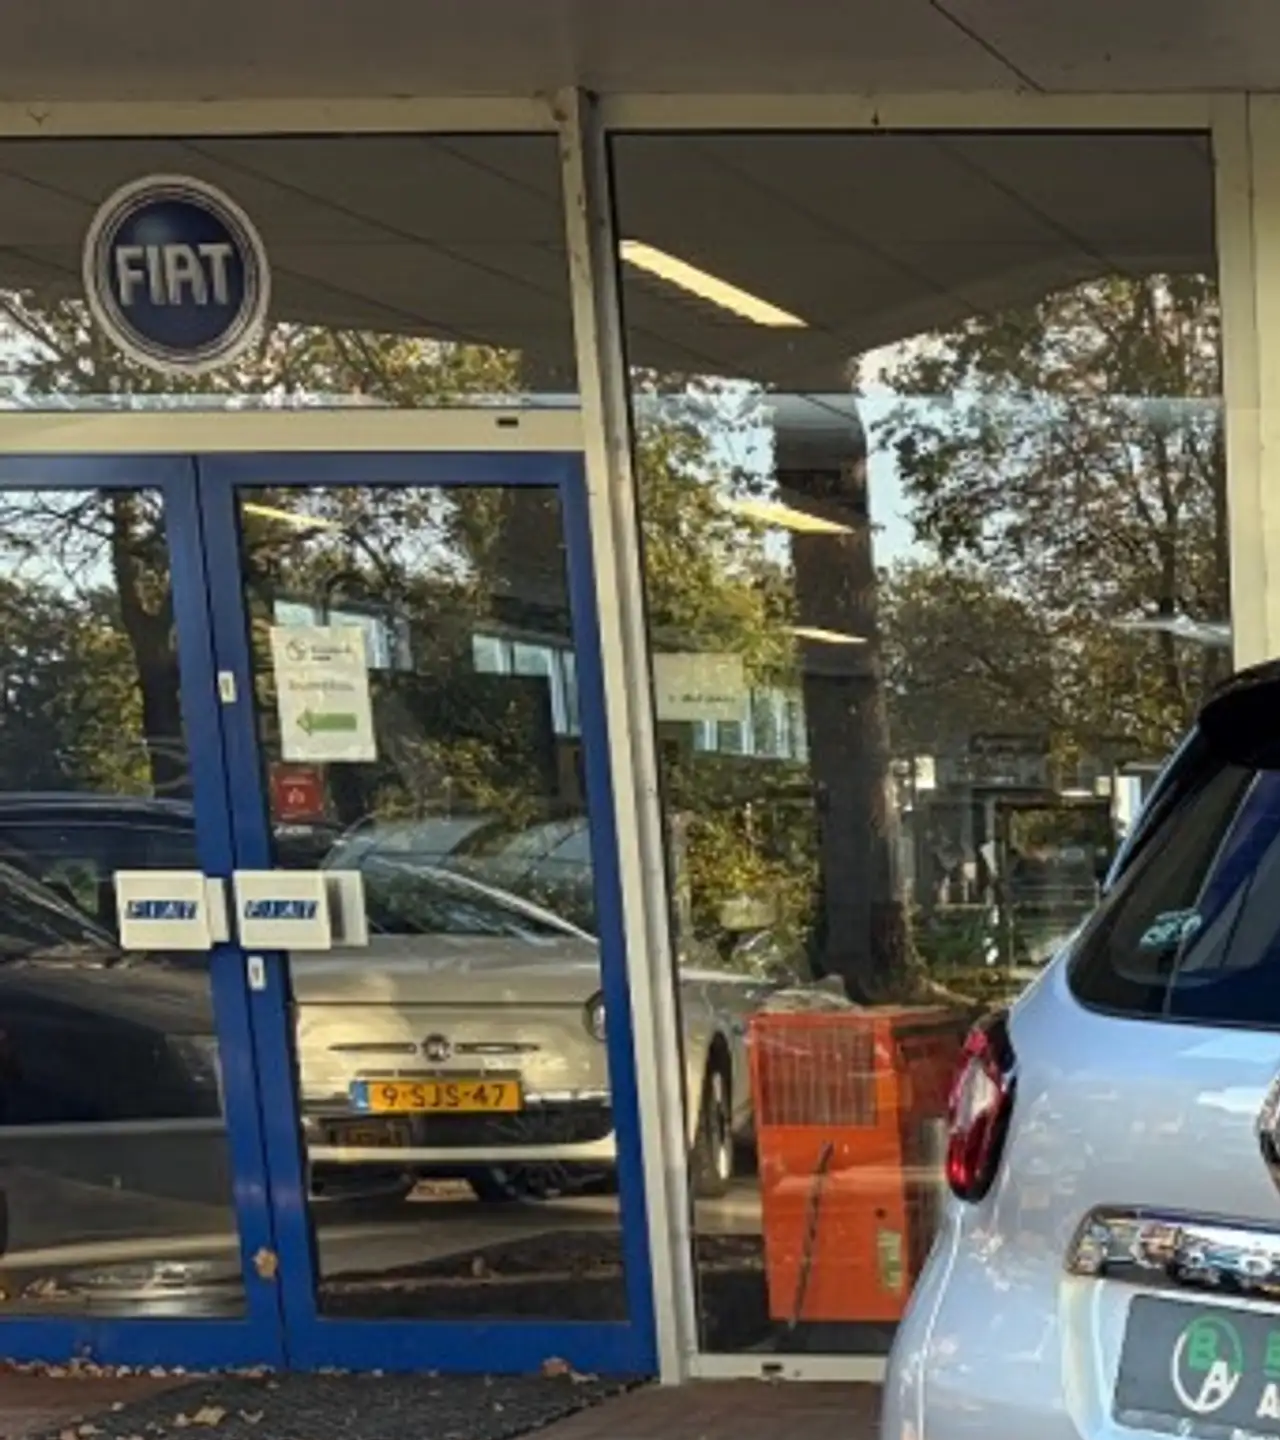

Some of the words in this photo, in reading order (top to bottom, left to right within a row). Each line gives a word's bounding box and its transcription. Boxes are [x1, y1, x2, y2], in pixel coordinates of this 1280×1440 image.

[116, 242, 232, 306] FIAT
[126, 901, 197, 920] FIAT
[245, 900, 318, 920] FIAT
